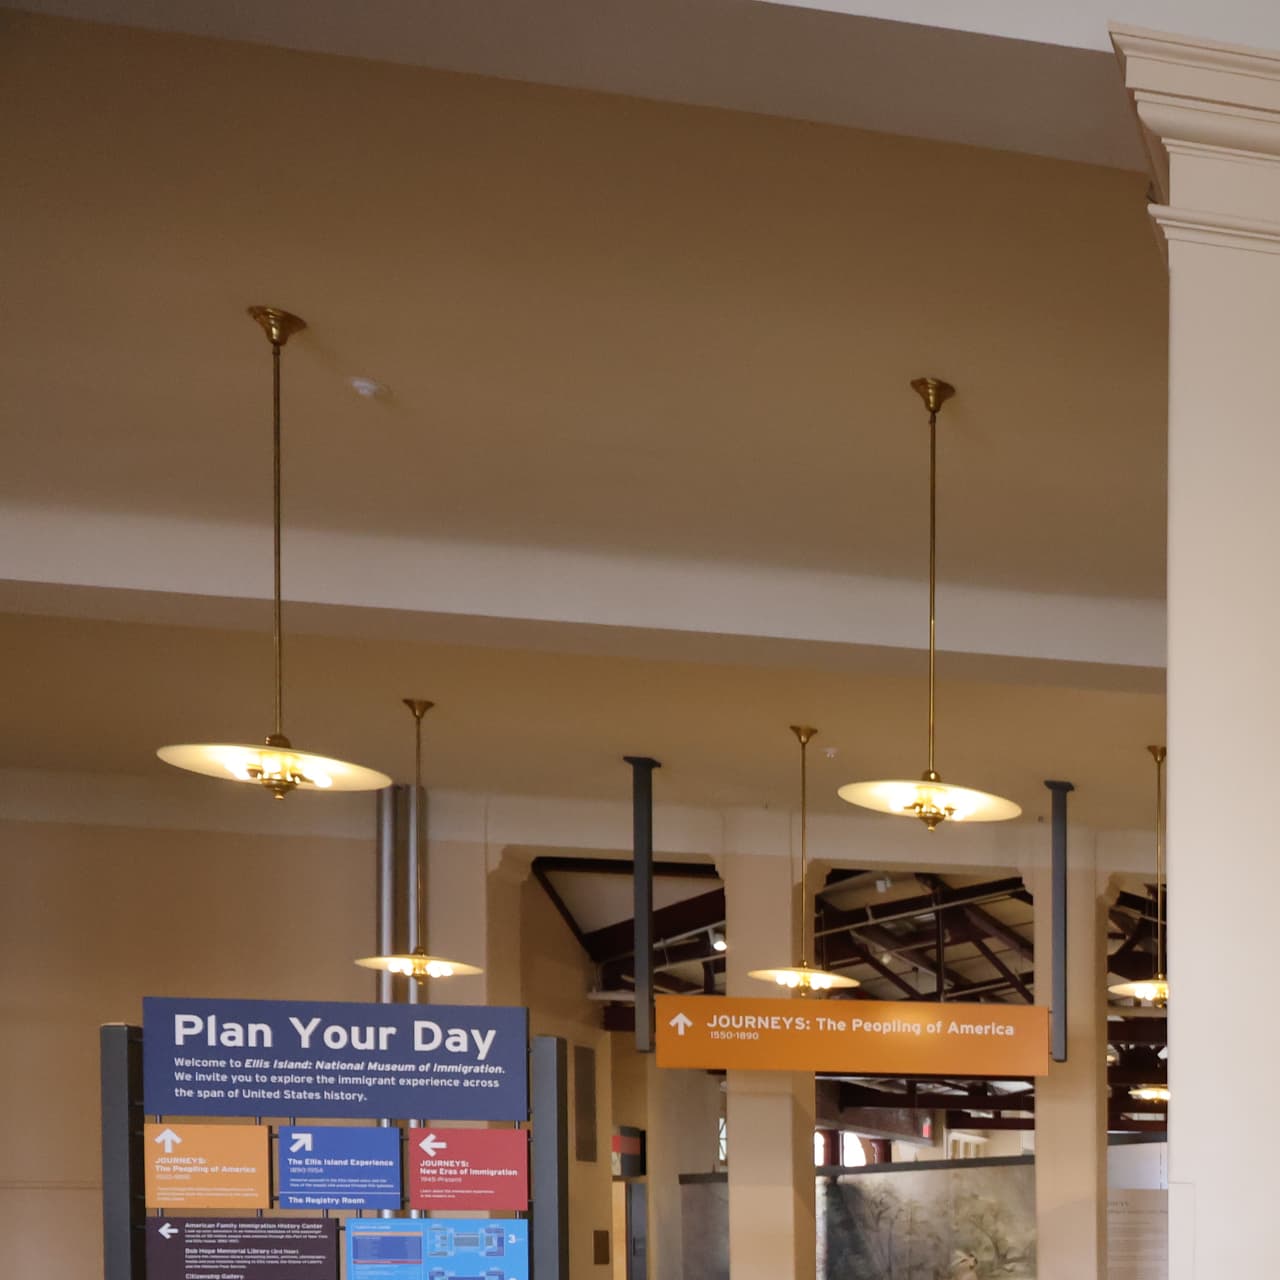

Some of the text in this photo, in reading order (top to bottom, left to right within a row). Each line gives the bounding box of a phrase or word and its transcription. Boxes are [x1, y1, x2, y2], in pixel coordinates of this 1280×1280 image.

[707, 1015, 1014, 1035] JOURNEYS: The Peopling of America
[175, 1014, 496, 1060] Plan Your Day
[174, 1057, 504, 1074] Welcome to Ellis Island: National Museum of Immigration.
[174, 1072, 499, 1087] We invite you to explore the immigrant experience across
[174, 1088, 367, 1102] the span of United States history.
[288, 1158, 303, 1166] The
[305, 1158, 322, 1166] Ellis
[350, 1159, 394, 1168] Experience
[439, 1168, 458, 1176] Eras
[459, 1168, 468, 1176] of
[469, 1168, 518, 1177] Immigration
[288, 1196, 304, 1204] The
[305, 1197, 340, 1205] Registry
[508, 1234, 517, 1244] 3
